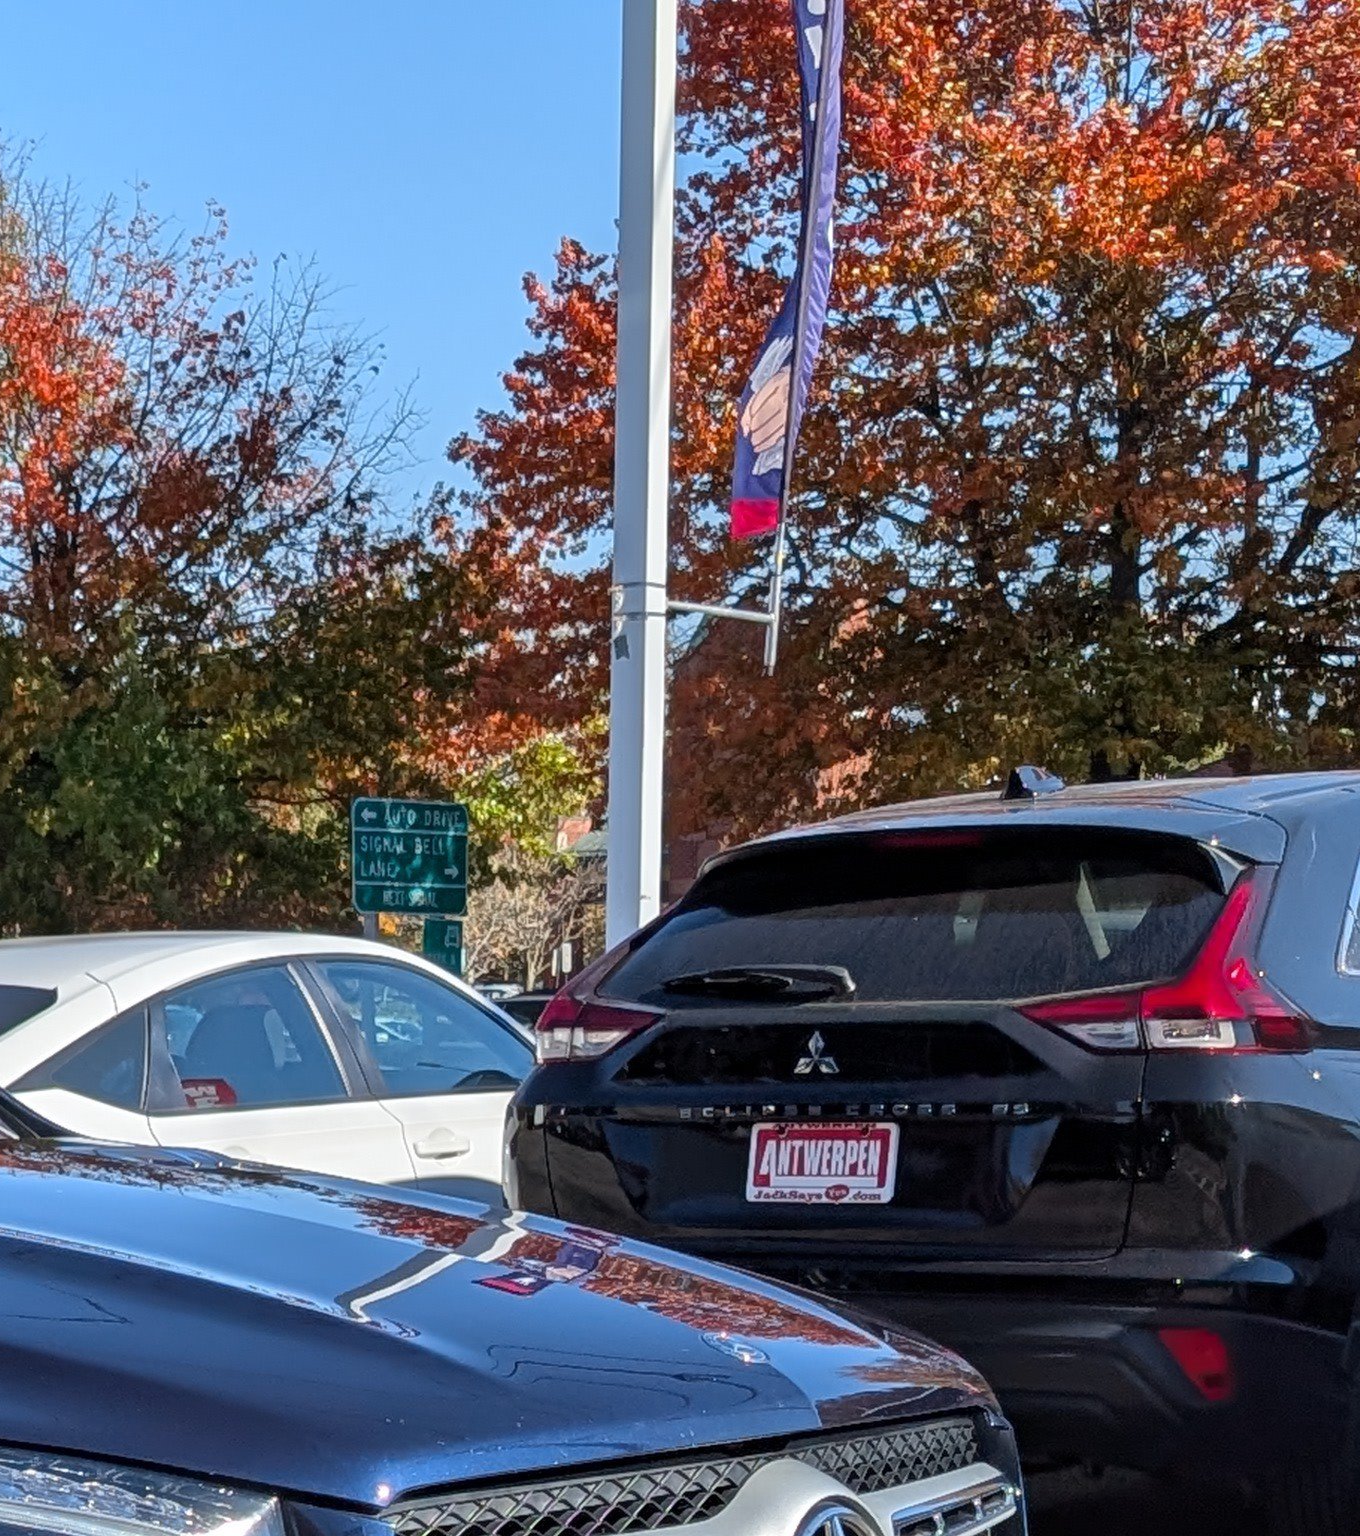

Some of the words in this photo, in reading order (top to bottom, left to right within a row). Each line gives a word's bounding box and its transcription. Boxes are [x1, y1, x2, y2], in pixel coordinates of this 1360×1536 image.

[424, 810, 460, 828] DRIVE
[360, 835, 407, 855] SIGNAL
[414, 837, 445, 856] BELL
[360, 860, 399, 878] LANE
[759, 1139, 881, 1177] ANTWERPEN
